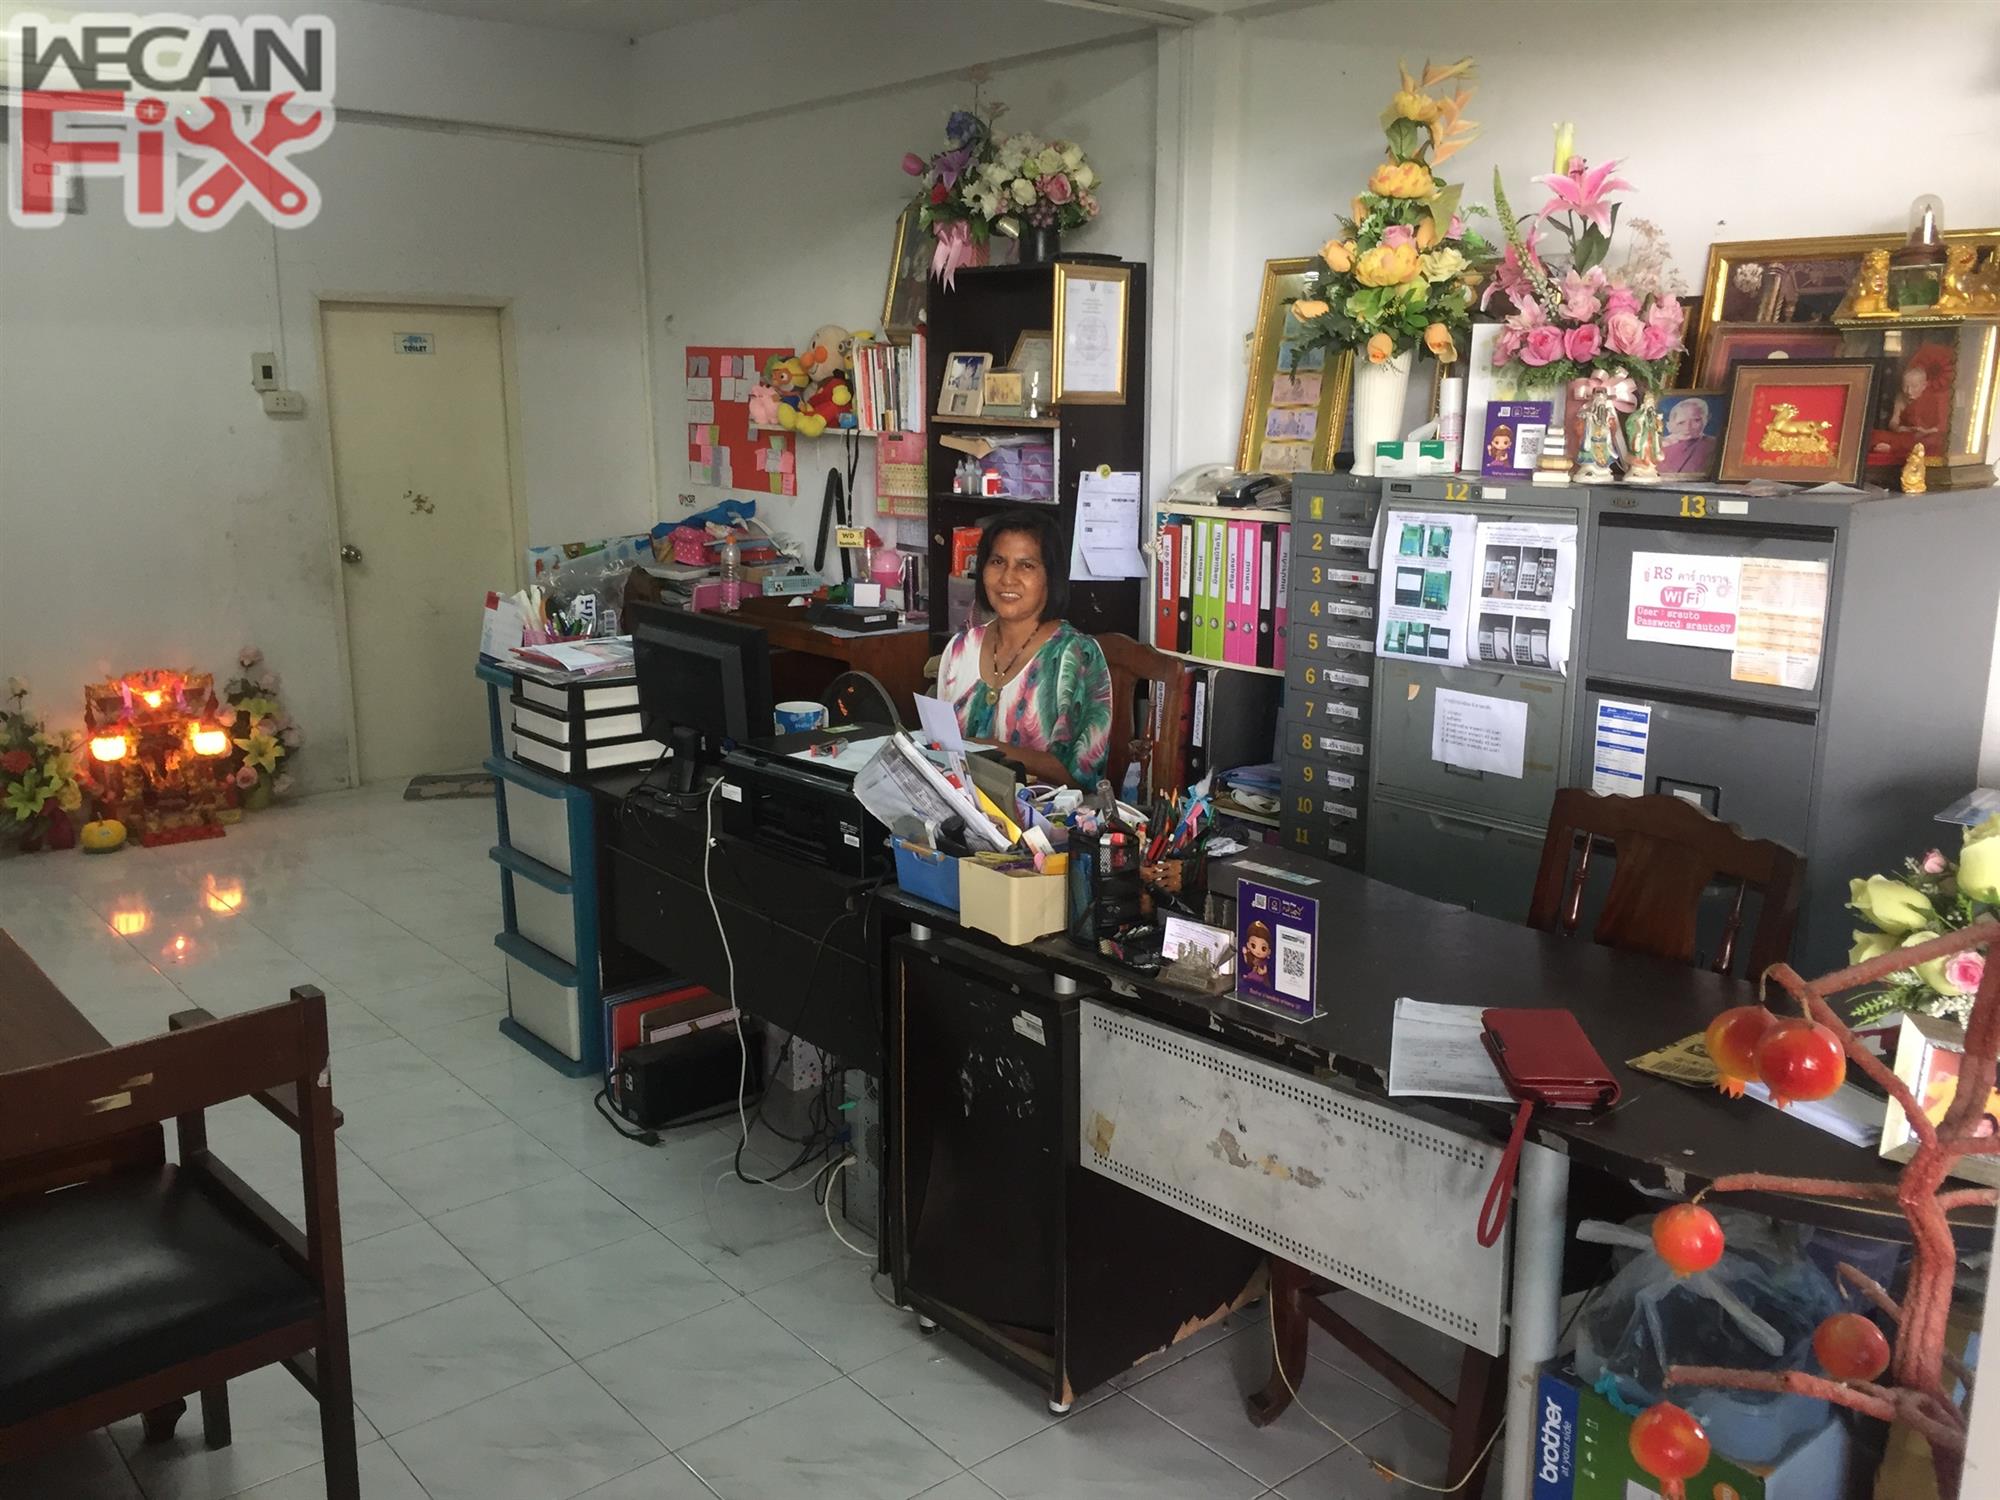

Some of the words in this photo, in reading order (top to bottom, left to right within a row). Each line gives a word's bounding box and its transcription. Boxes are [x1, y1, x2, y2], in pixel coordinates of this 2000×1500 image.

[1445, 482, 1470, 501] 12
[1312, 497, 1323, 515] 1
[1679, 495, 1706, 518] 13
[1312, 533, 1323, 551] 2
[1311, 567, 1322, 584] 3
[1653, 566, 1673, 580] RS
[1310, 600, 1321, 617] 4
[1308, 633, 1319, 650] 5
[1305, 667, 1316, 685] 6
[1305, 702, 1315, 718] 7
[1301, 733, 1312, 750] 8
[1303, 766, 1313, 782] 9
[1296, 796, 1312, 814] 10
[1295, 827, 1309, 844] 11
[1539, 1396, 1562, 1484] brother
[1562, 1421, 1572, 1442] side
[1562, 1443, 1572, 1466] your
